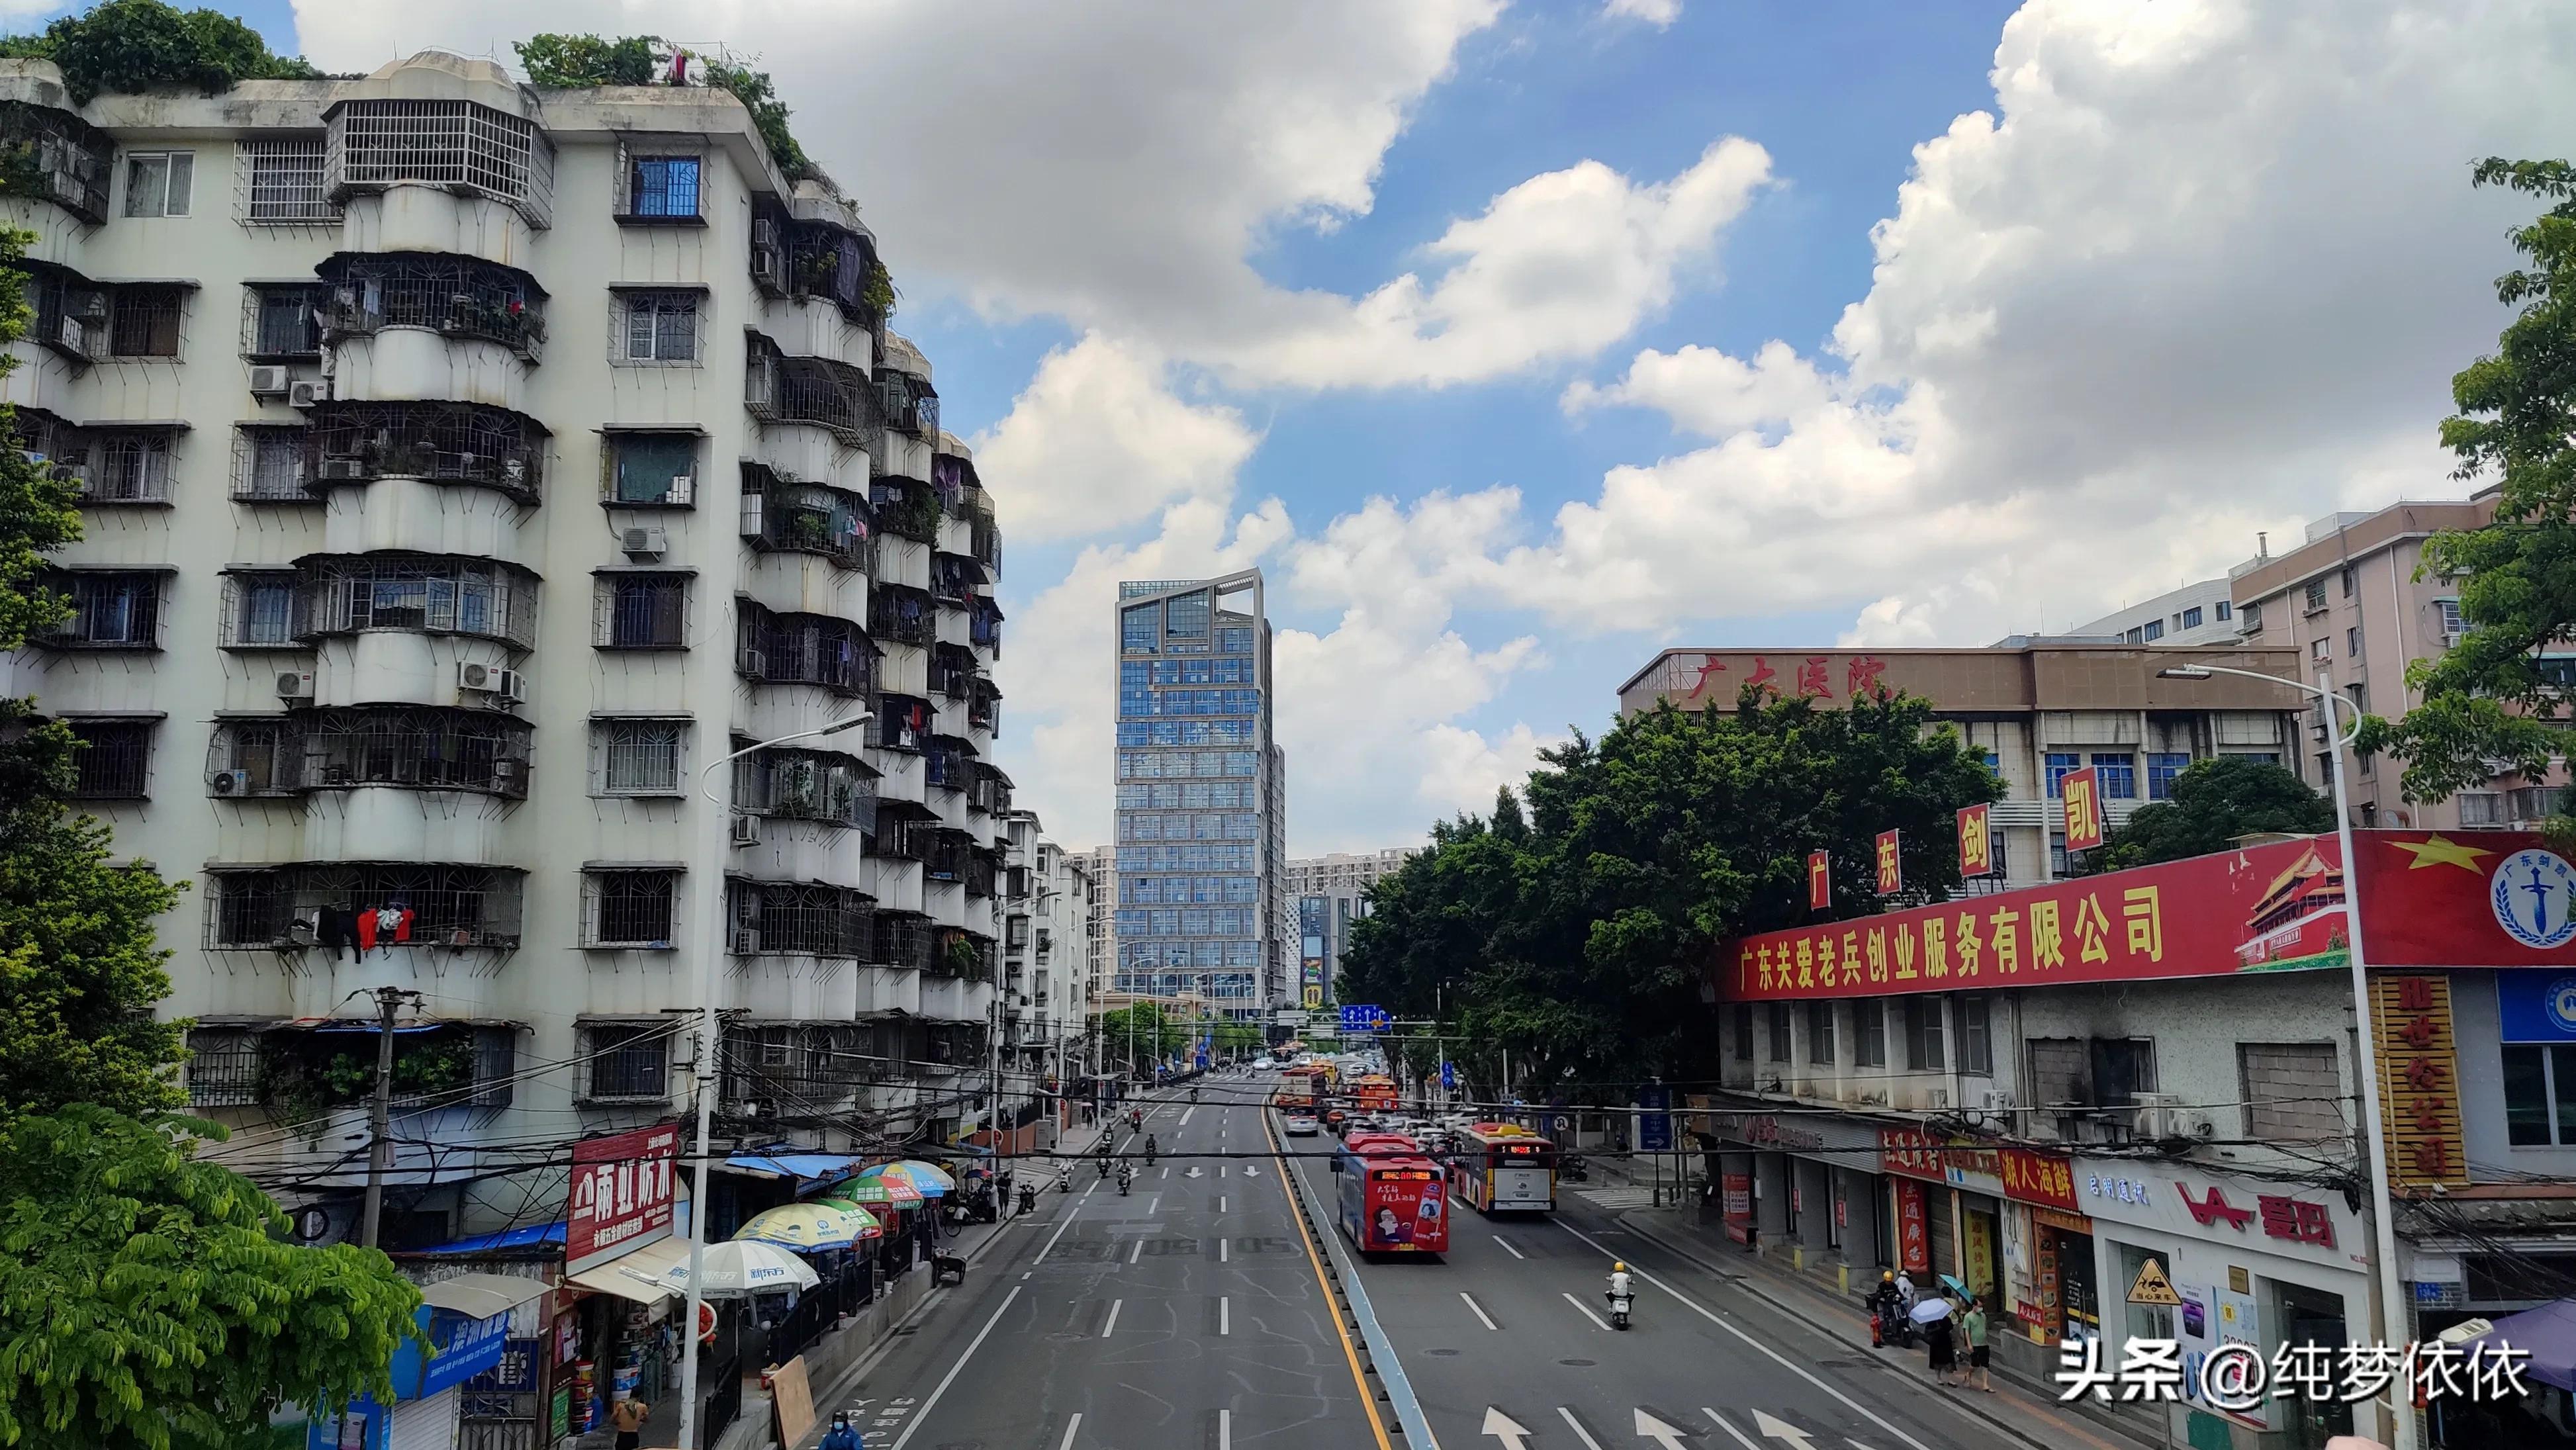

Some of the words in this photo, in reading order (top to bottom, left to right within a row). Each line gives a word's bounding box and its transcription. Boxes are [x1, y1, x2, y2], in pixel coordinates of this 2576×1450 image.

[1688, 656, 1893, 700] 广大医院
[2505, 854, 2567, 878] 广东剑凯
[1740, 885, 2163, 991] 广东关爱老兵创业服务有限公司
[596, 1149, 672, 1223] 雨虹防水
[2001, 1152, 2071, 1201] 潮人海鲜
[2089, 1171, 2149, 1205] 启明通讯
[2258, 1194, 2338, 1249] 爱玛
[750, 1266, 785, 1281] 新东方
[2136, 1292, 2172, 1302] 当心来车
